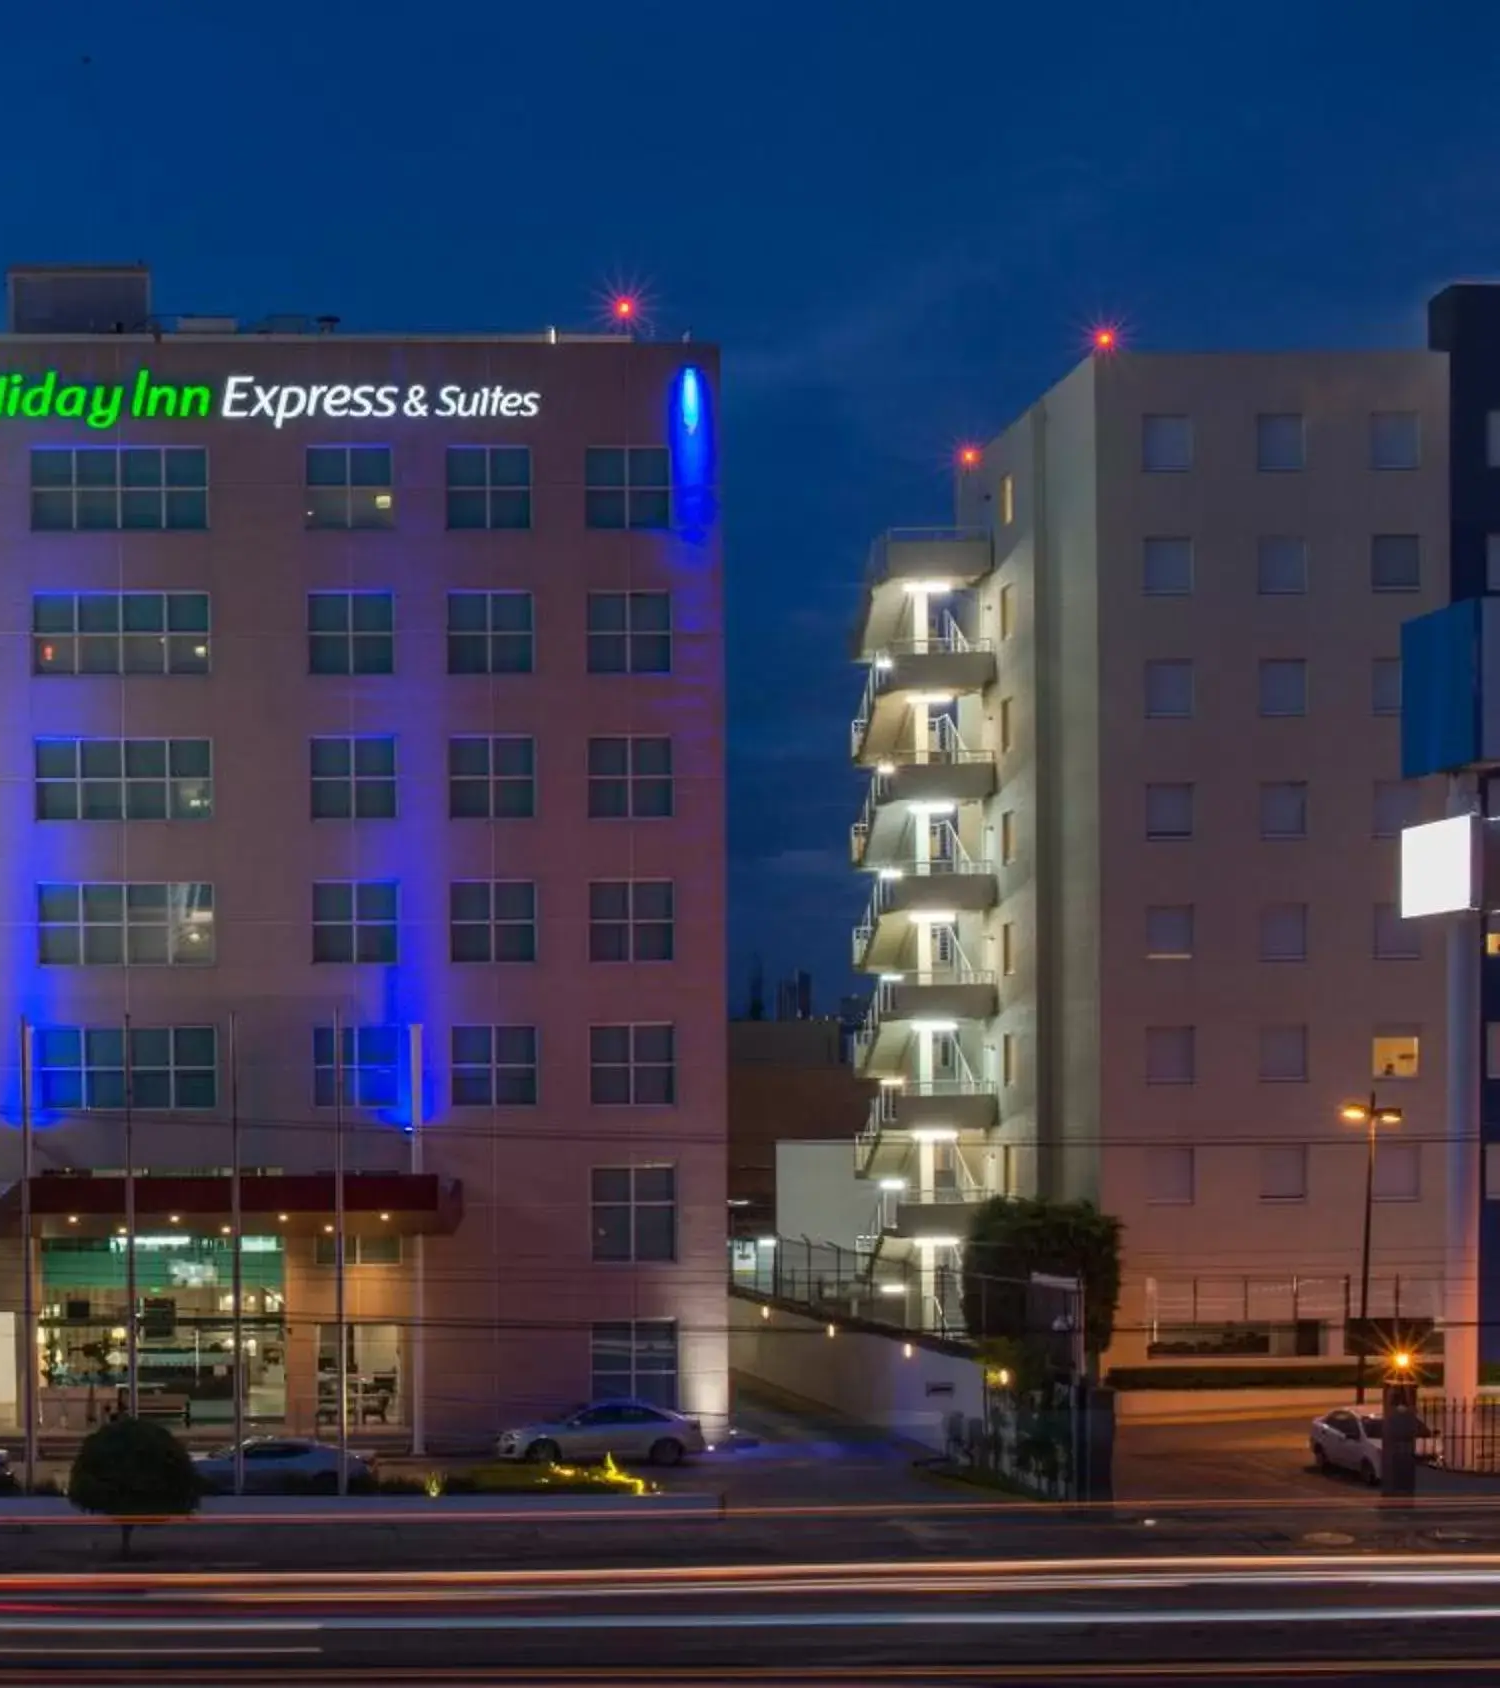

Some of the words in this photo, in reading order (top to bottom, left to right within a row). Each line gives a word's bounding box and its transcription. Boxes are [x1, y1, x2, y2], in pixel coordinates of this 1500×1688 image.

[132, 370, 211, 417] Inn
[222, 375, 399, 429] Express
[403, 384, 429, 418] &
[435, 385, 541, 418] Suites
